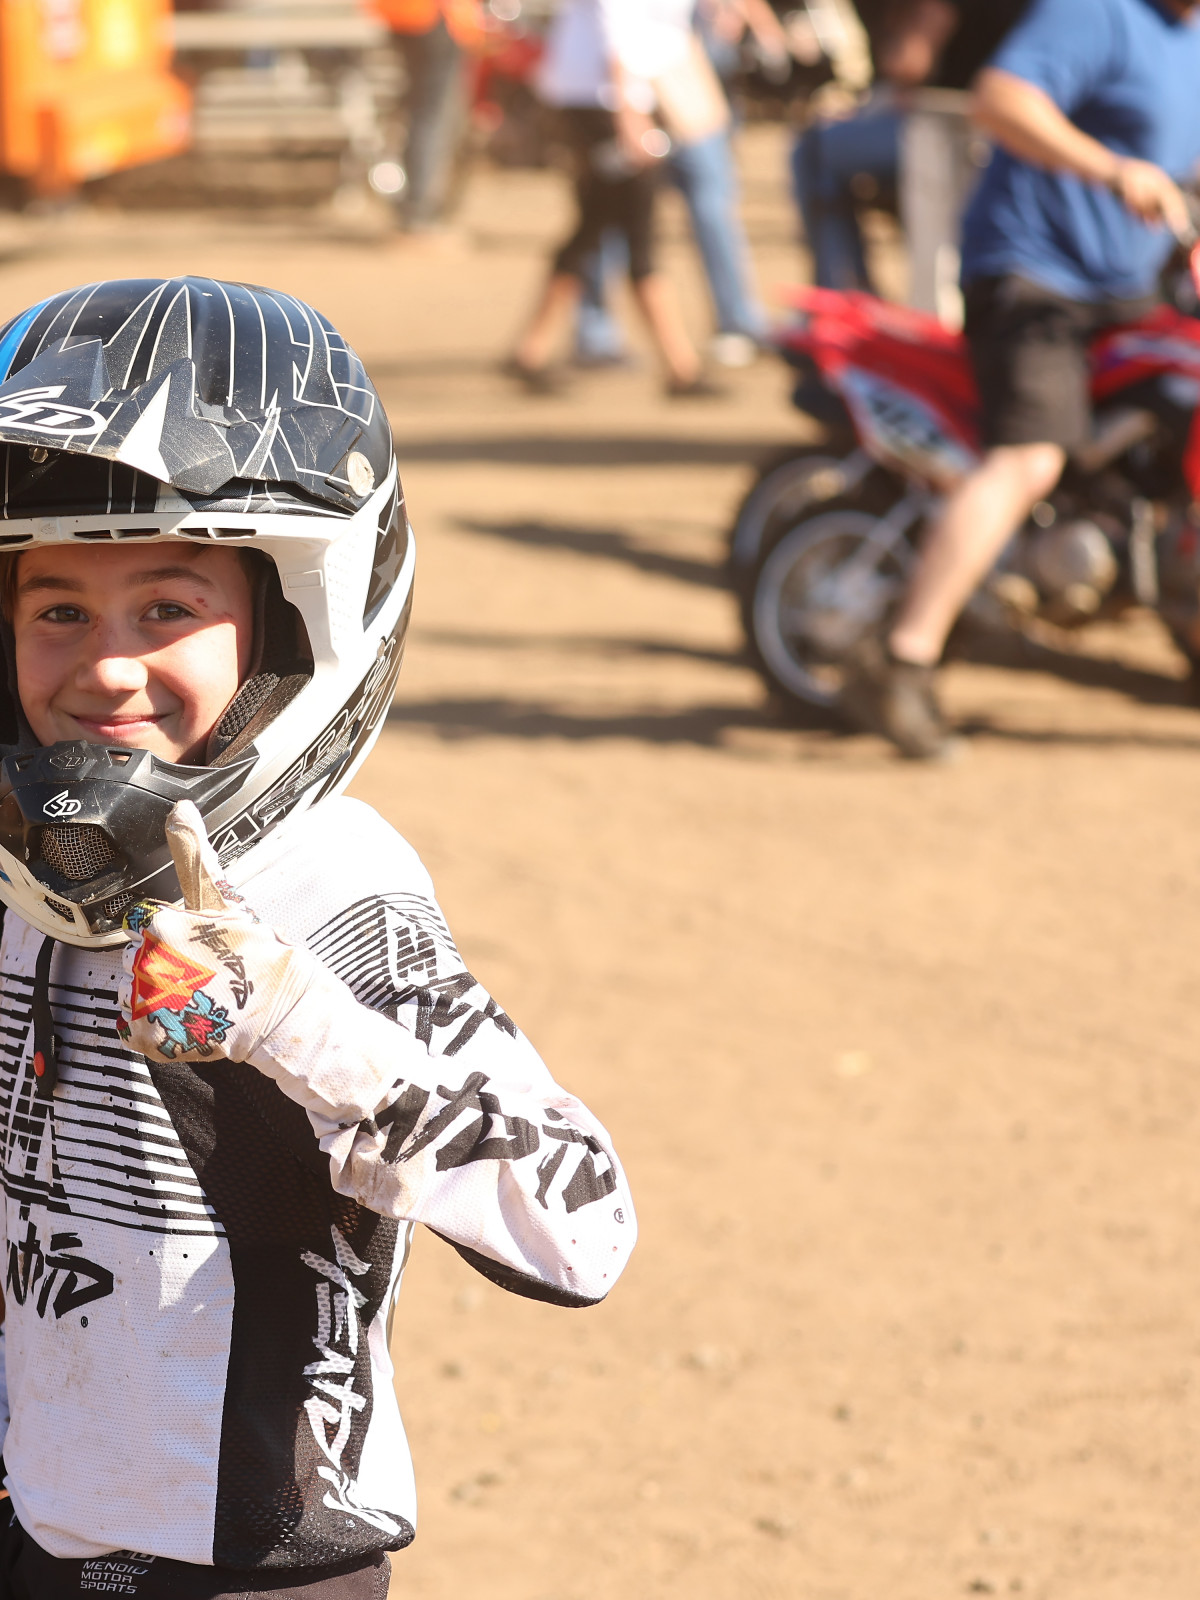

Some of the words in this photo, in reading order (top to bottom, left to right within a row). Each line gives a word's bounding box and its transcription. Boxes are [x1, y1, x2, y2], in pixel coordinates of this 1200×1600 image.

[43, 789, 82, 818] 6D
[81, 1571, 133, 1584] MOTOR
[80, 1580, 138, 1594] SPORTS
